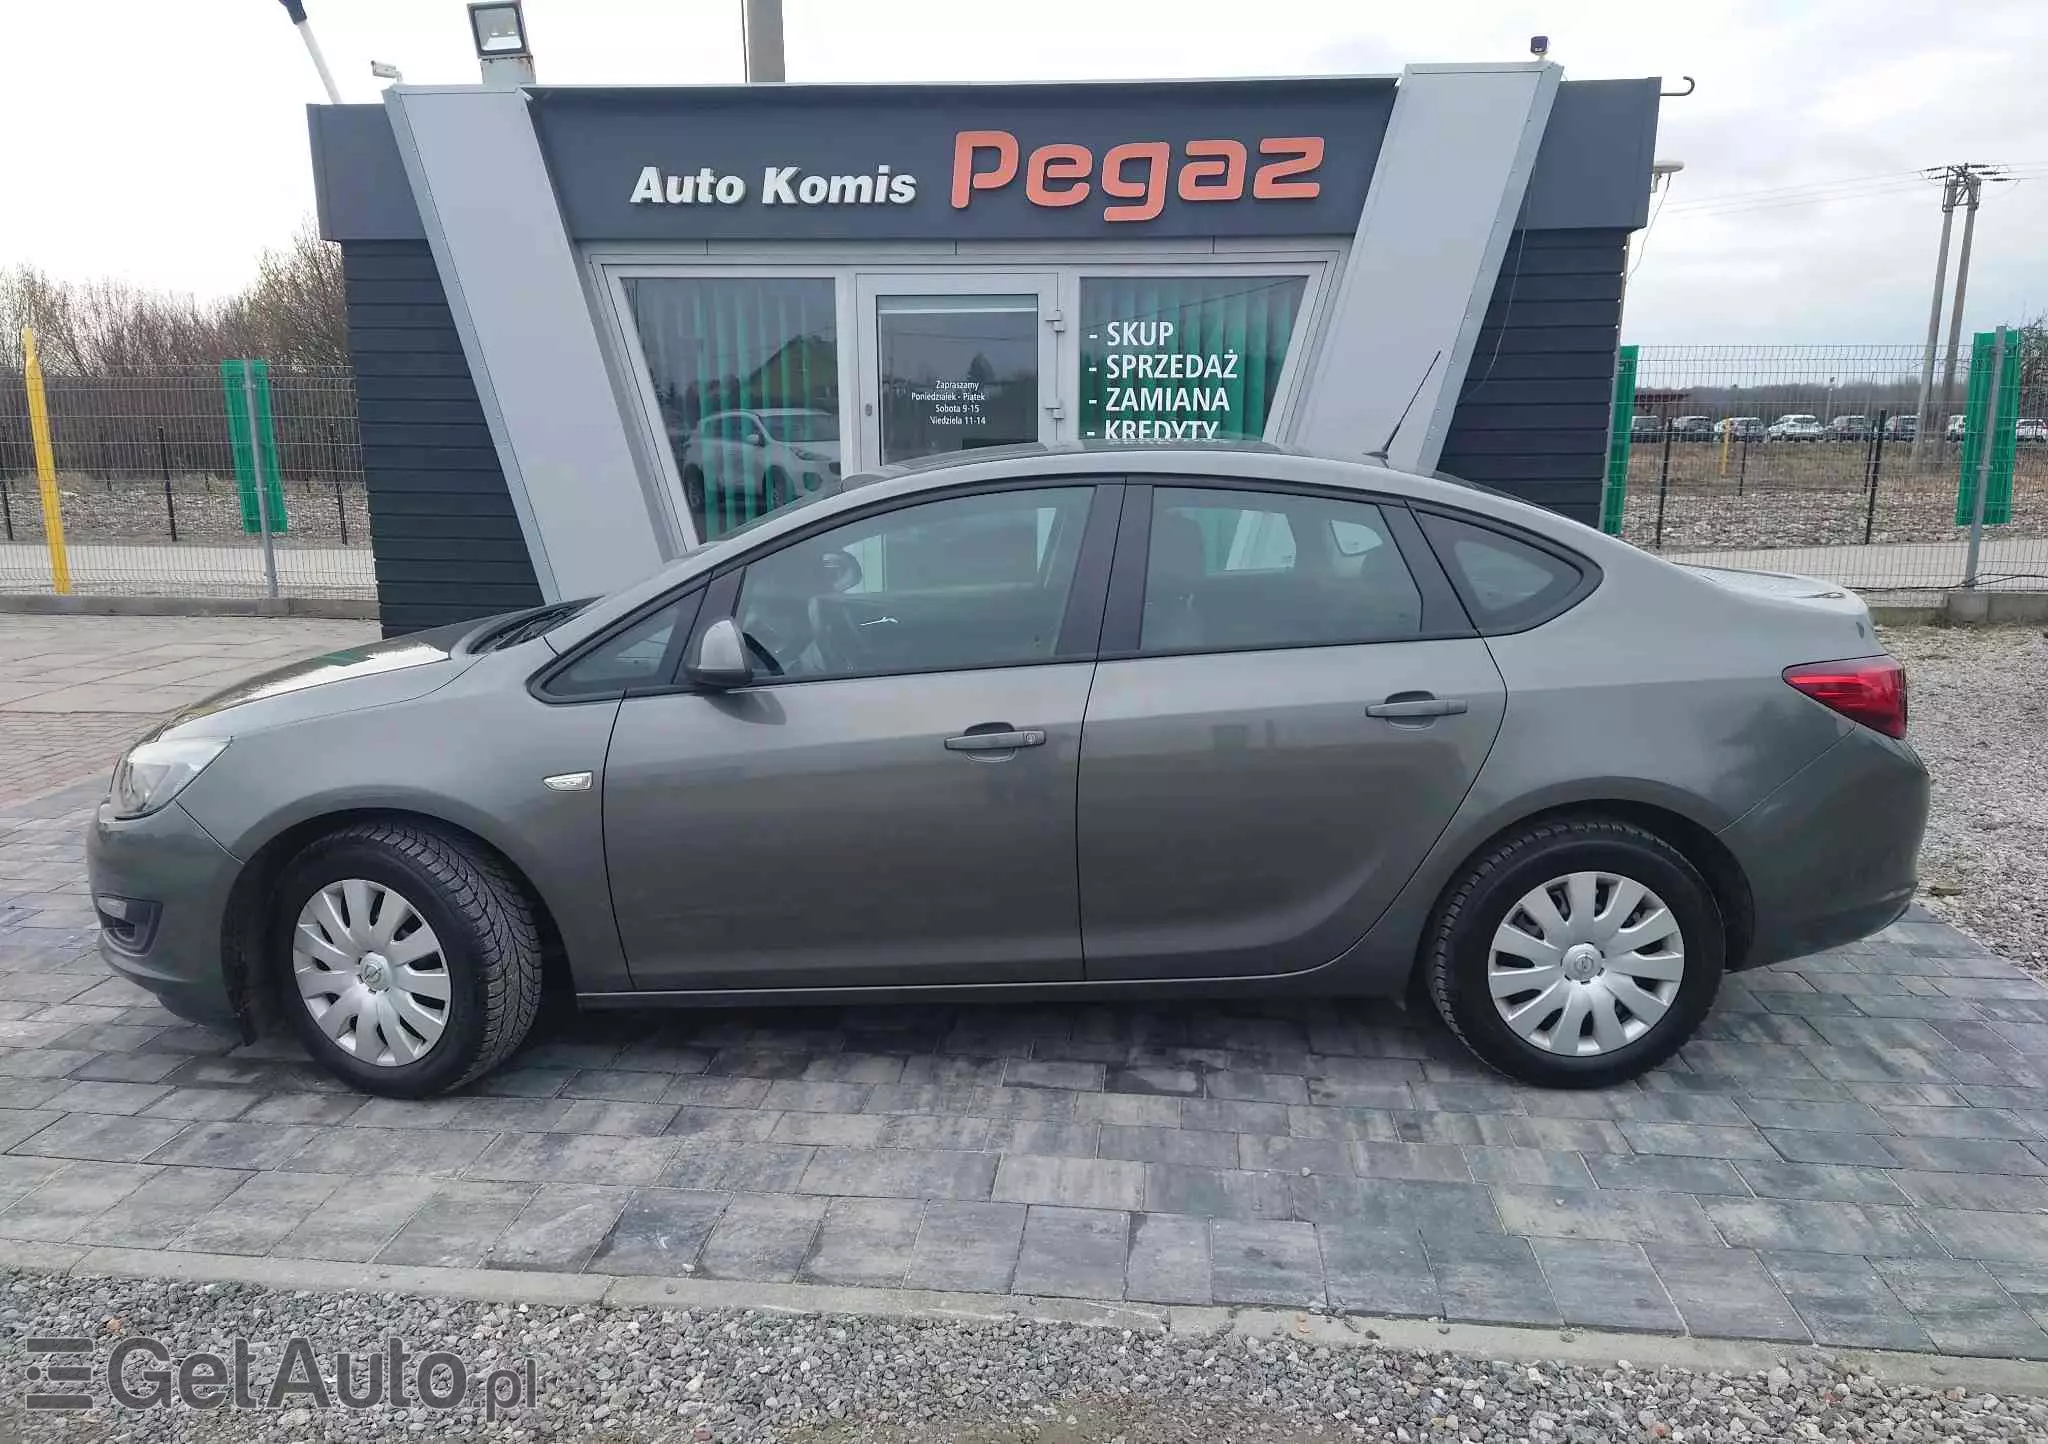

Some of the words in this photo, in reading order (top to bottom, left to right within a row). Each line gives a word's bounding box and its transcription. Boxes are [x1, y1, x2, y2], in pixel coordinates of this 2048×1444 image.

[629, 165, 747, 206] Auto
[760, 164, 917, 206] Komis
[951, 130, 1326, 223] Pegaz
[1107, 321, 1174, 346] SKUP
[1106, 349, 1239, 379] SPRZEDAŻ
[936, 380, 979, 391] Zapraszamy
[935, 404, 961, 413] Sobota
[962, 404, 980, 413] 9-15
[1105, 387, 1231, 412] ZAMIANA
[1105, 420, 1219, 440] KREDYTY
